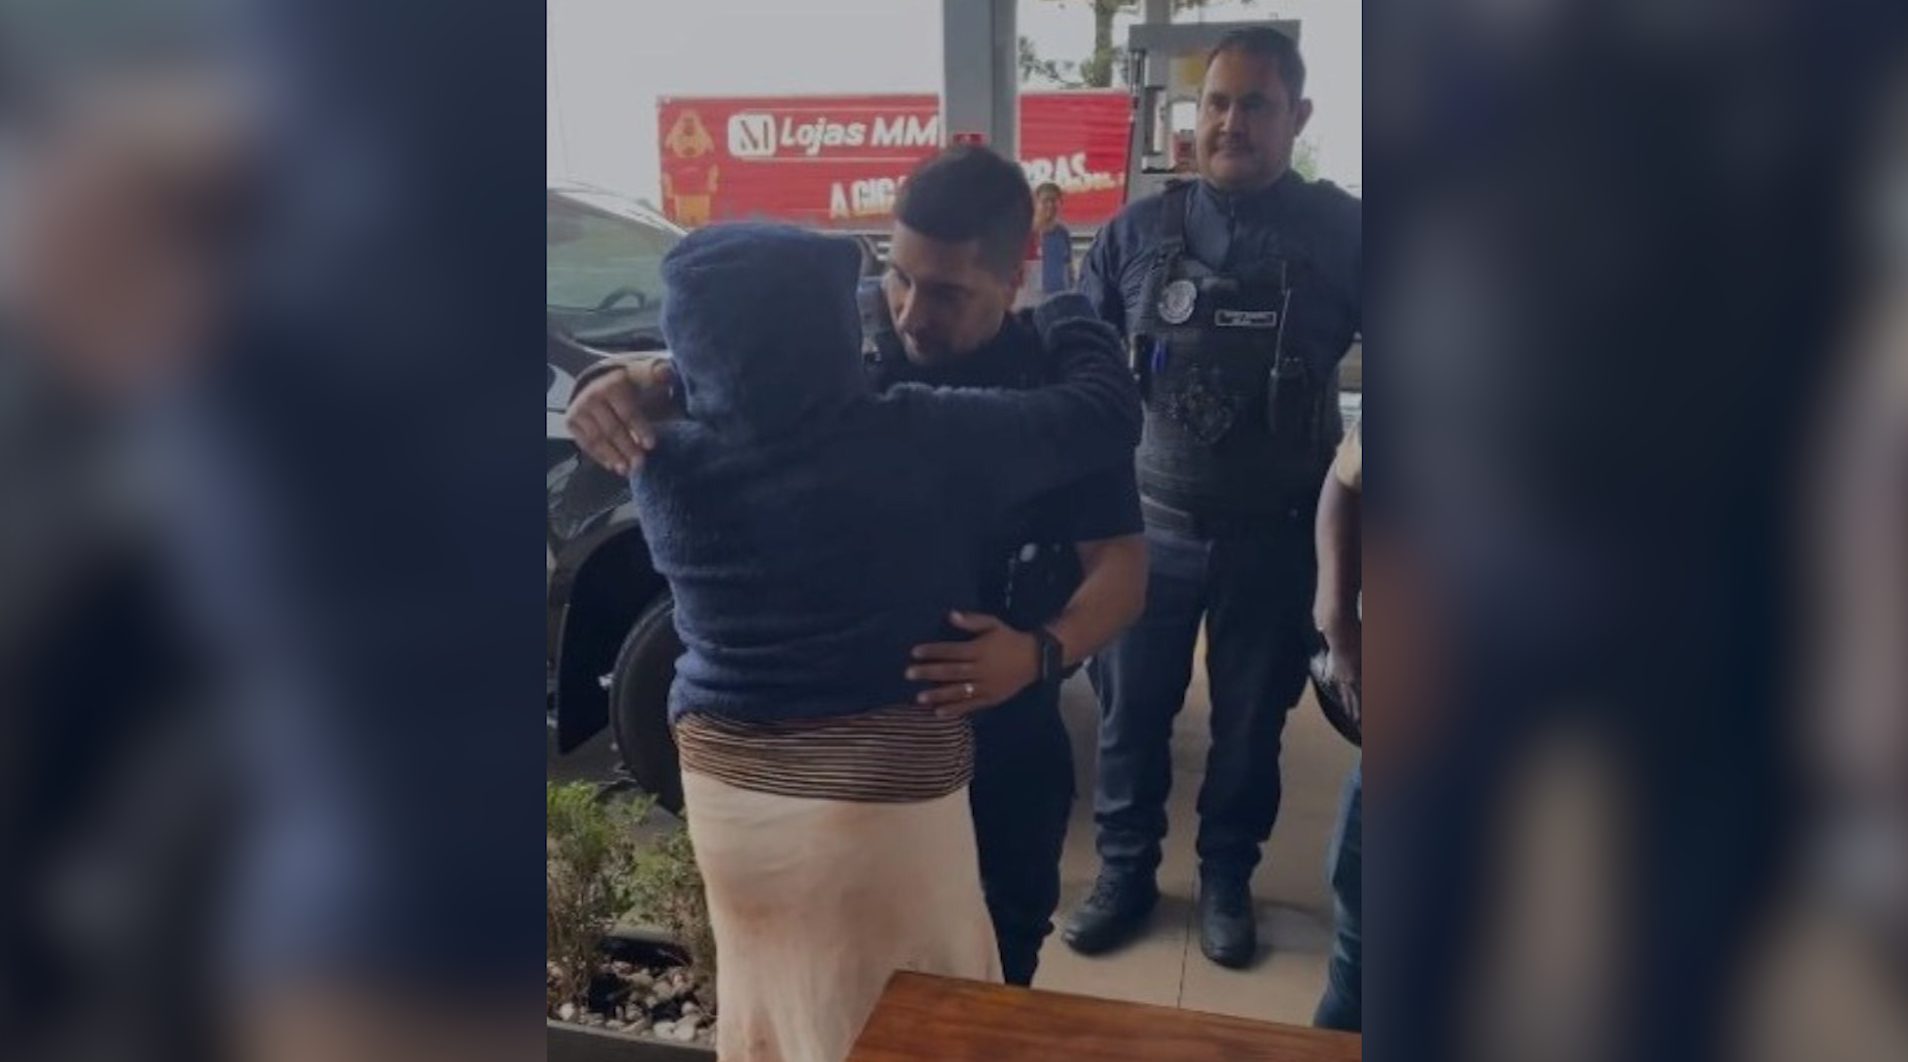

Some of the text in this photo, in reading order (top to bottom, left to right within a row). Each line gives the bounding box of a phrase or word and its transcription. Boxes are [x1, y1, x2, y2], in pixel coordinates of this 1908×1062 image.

[780, 116, 868, 156] Lojas
[871, 114, 940, 147] MM
[829, 182, 851, 220] A
[851, 175, 906, 217] GIG
